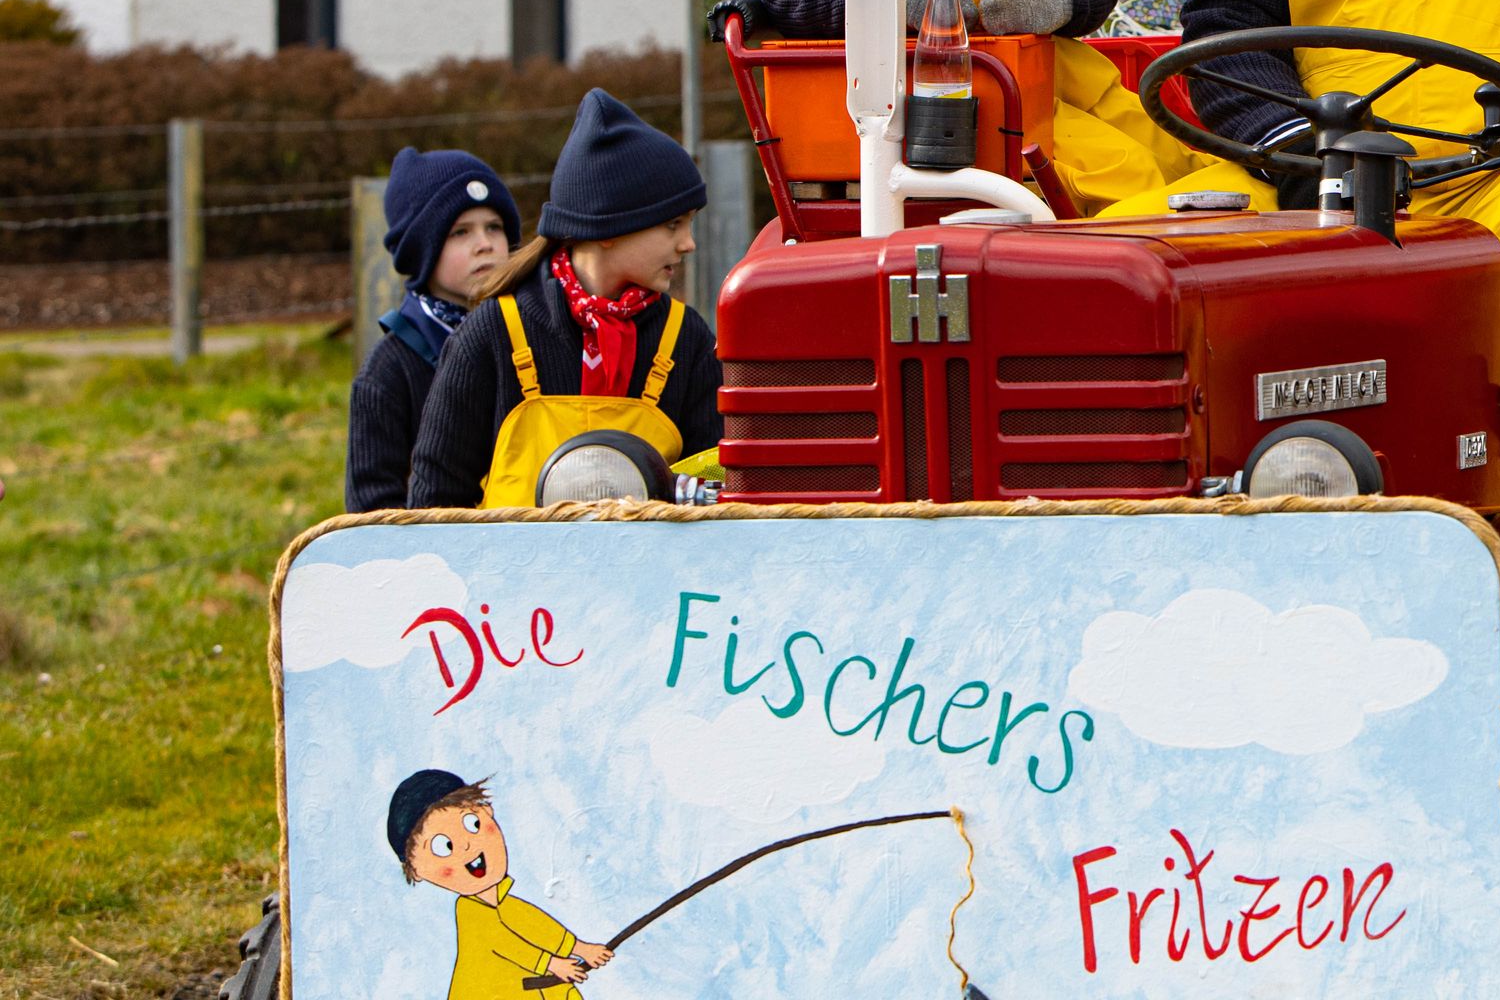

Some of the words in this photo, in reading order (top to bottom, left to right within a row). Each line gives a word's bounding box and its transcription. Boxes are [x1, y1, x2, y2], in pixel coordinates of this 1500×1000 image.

[402, 603, 584, 717] Die
[665, 591, 1094, 794] Fischers
[1071, 828, 1407, 974] Fritzen
